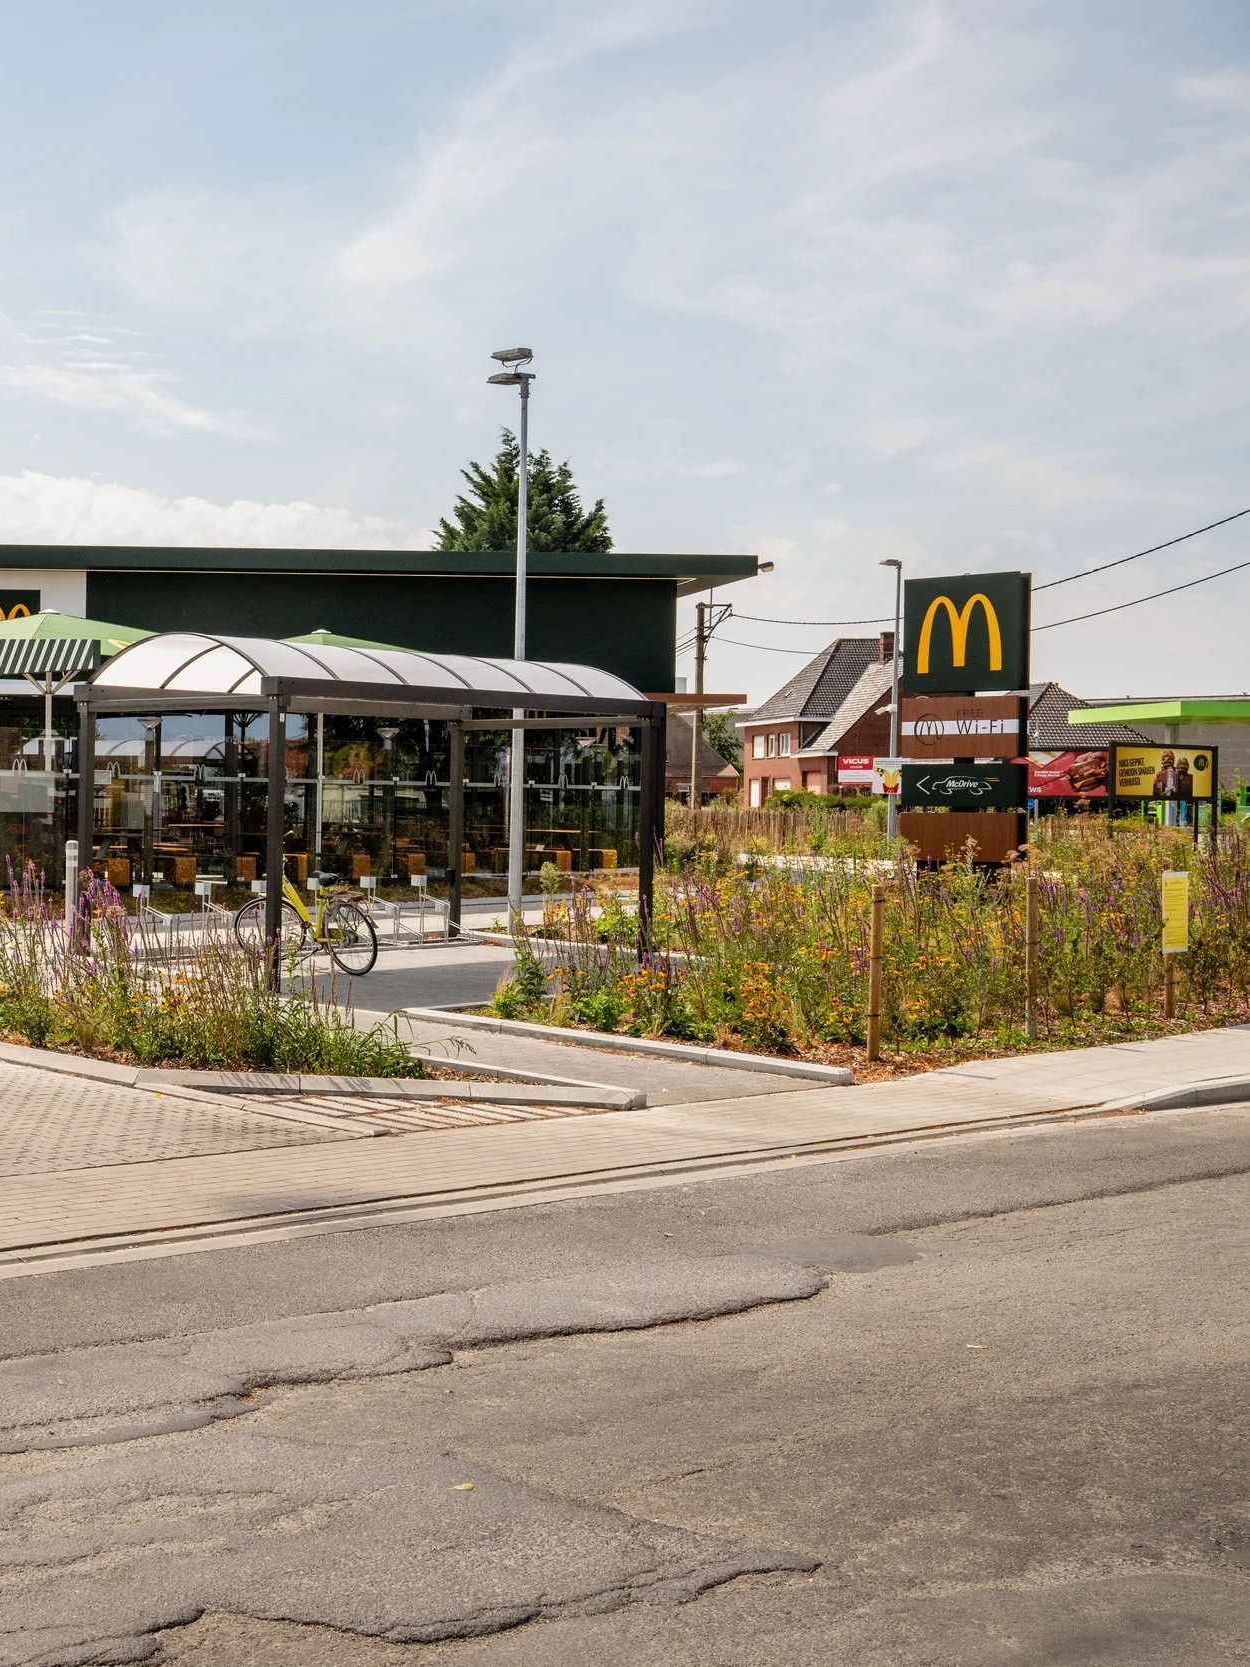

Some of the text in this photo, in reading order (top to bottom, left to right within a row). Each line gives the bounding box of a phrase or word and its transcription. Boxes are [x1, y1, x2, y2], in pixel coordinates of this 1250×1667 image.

[917, 593, 1002, 674] M
[956, 708, 983, 718] FREE
[956, 720, 1004, 735] Wi-Fi
[945, 779, 979, 788] McDrive
